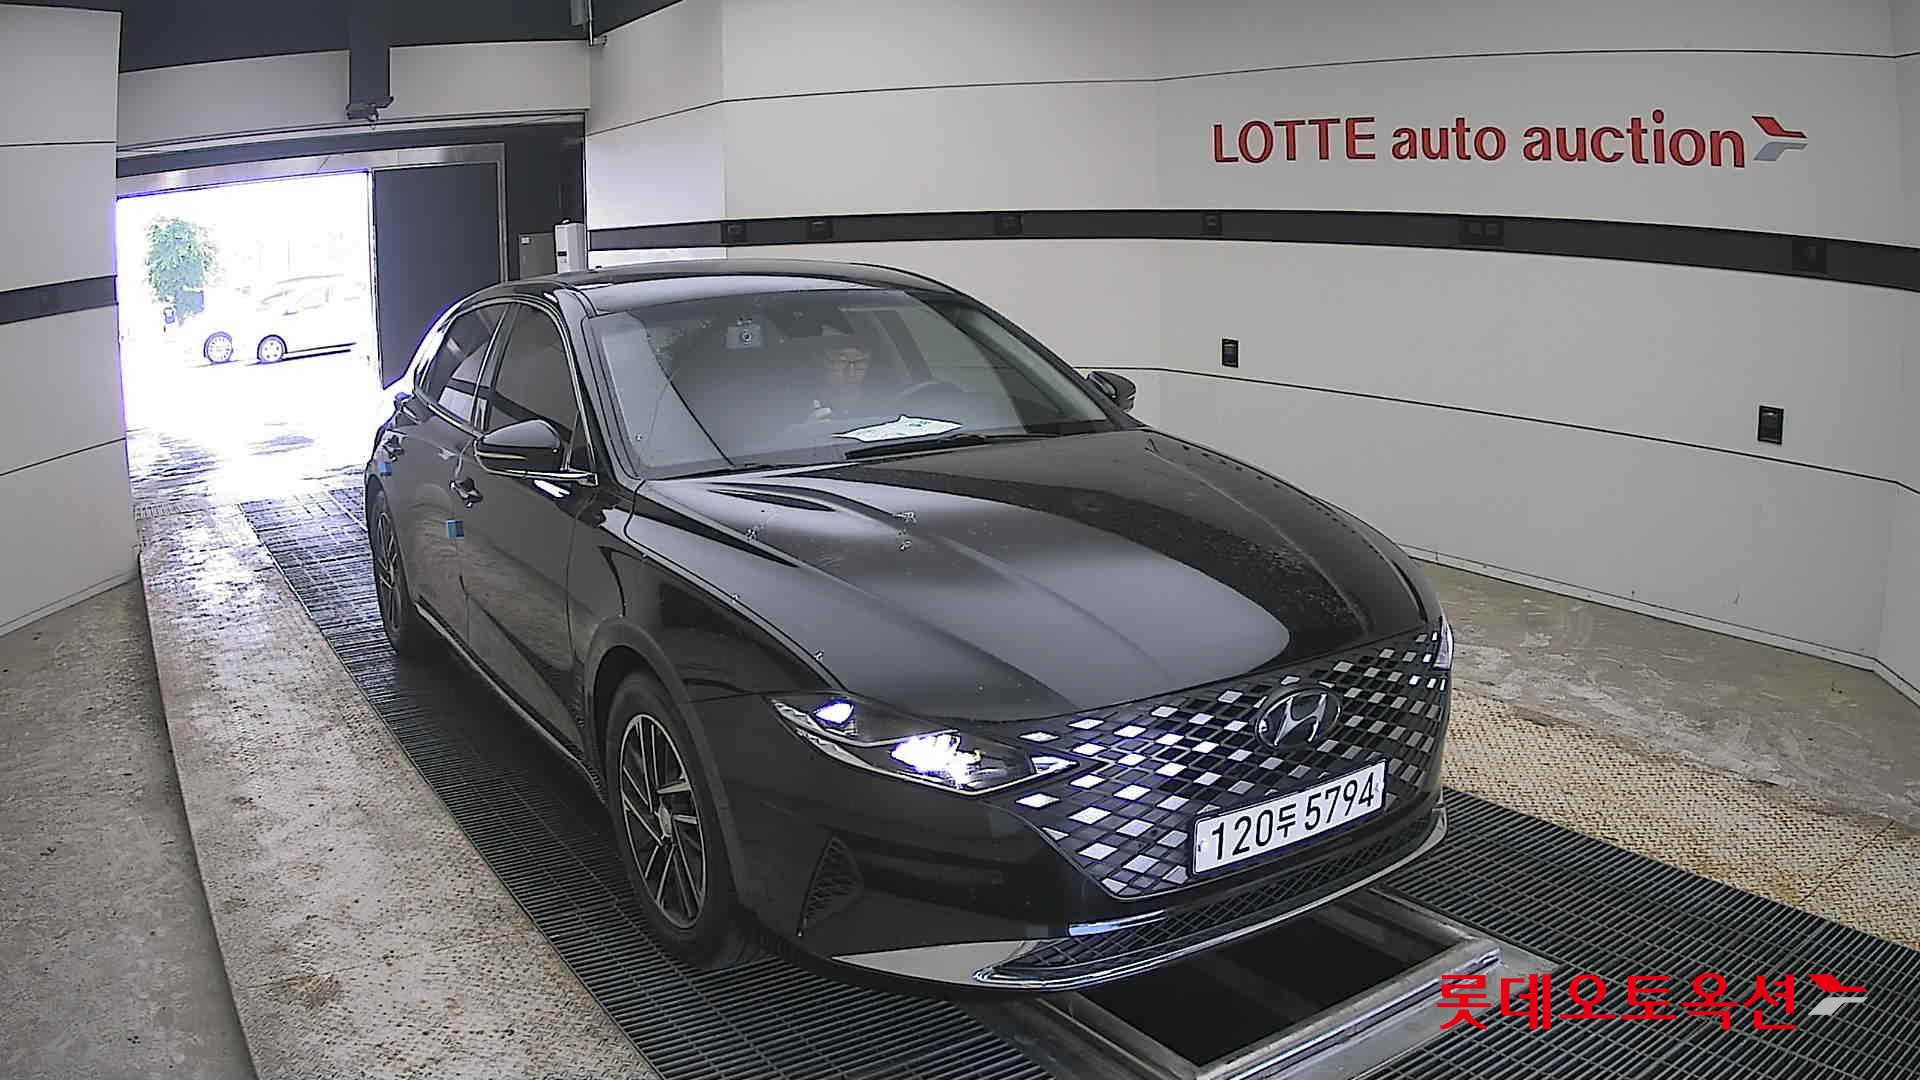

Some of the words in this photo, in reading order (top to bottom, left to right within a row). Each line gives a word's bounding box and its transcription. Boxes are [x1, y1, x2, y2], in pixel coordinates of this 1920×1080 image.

[1213, 116, 1376, 163] LOTTE
[1391, 117, 1507, 160] auto
[1522, 109, 1746, 169] auction
[1211, 803, 1297, 861] 120두
[1304, 772, 1374, 831] 5794
